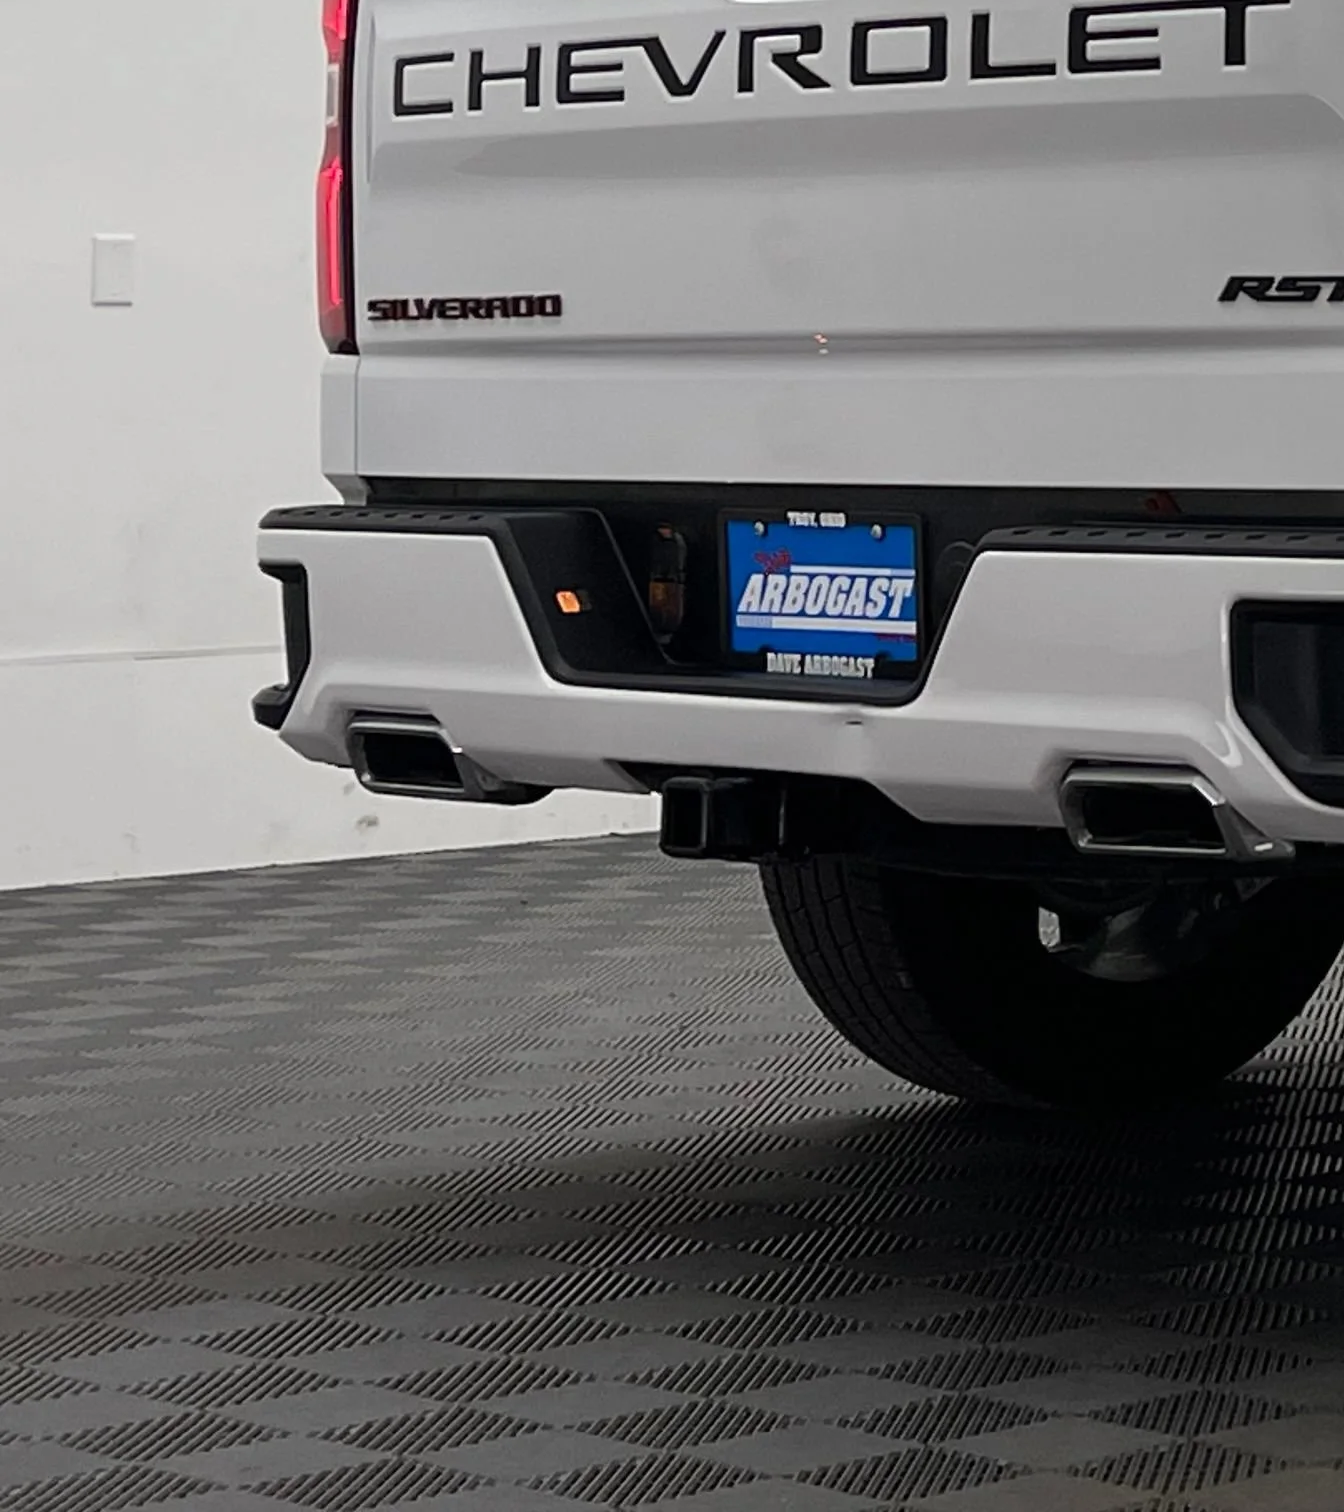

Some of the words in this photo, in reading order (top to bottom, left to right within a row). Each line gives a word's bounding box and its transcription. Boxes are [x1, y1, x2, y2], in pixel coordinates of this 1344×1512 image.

[367, 294, 562, 321] SILVERADO
[737, 573, 914, 618] ARBOGAST
[766, 652, 801, 674] DAVE
[803, 654, 875, 678] ARBOGAST
